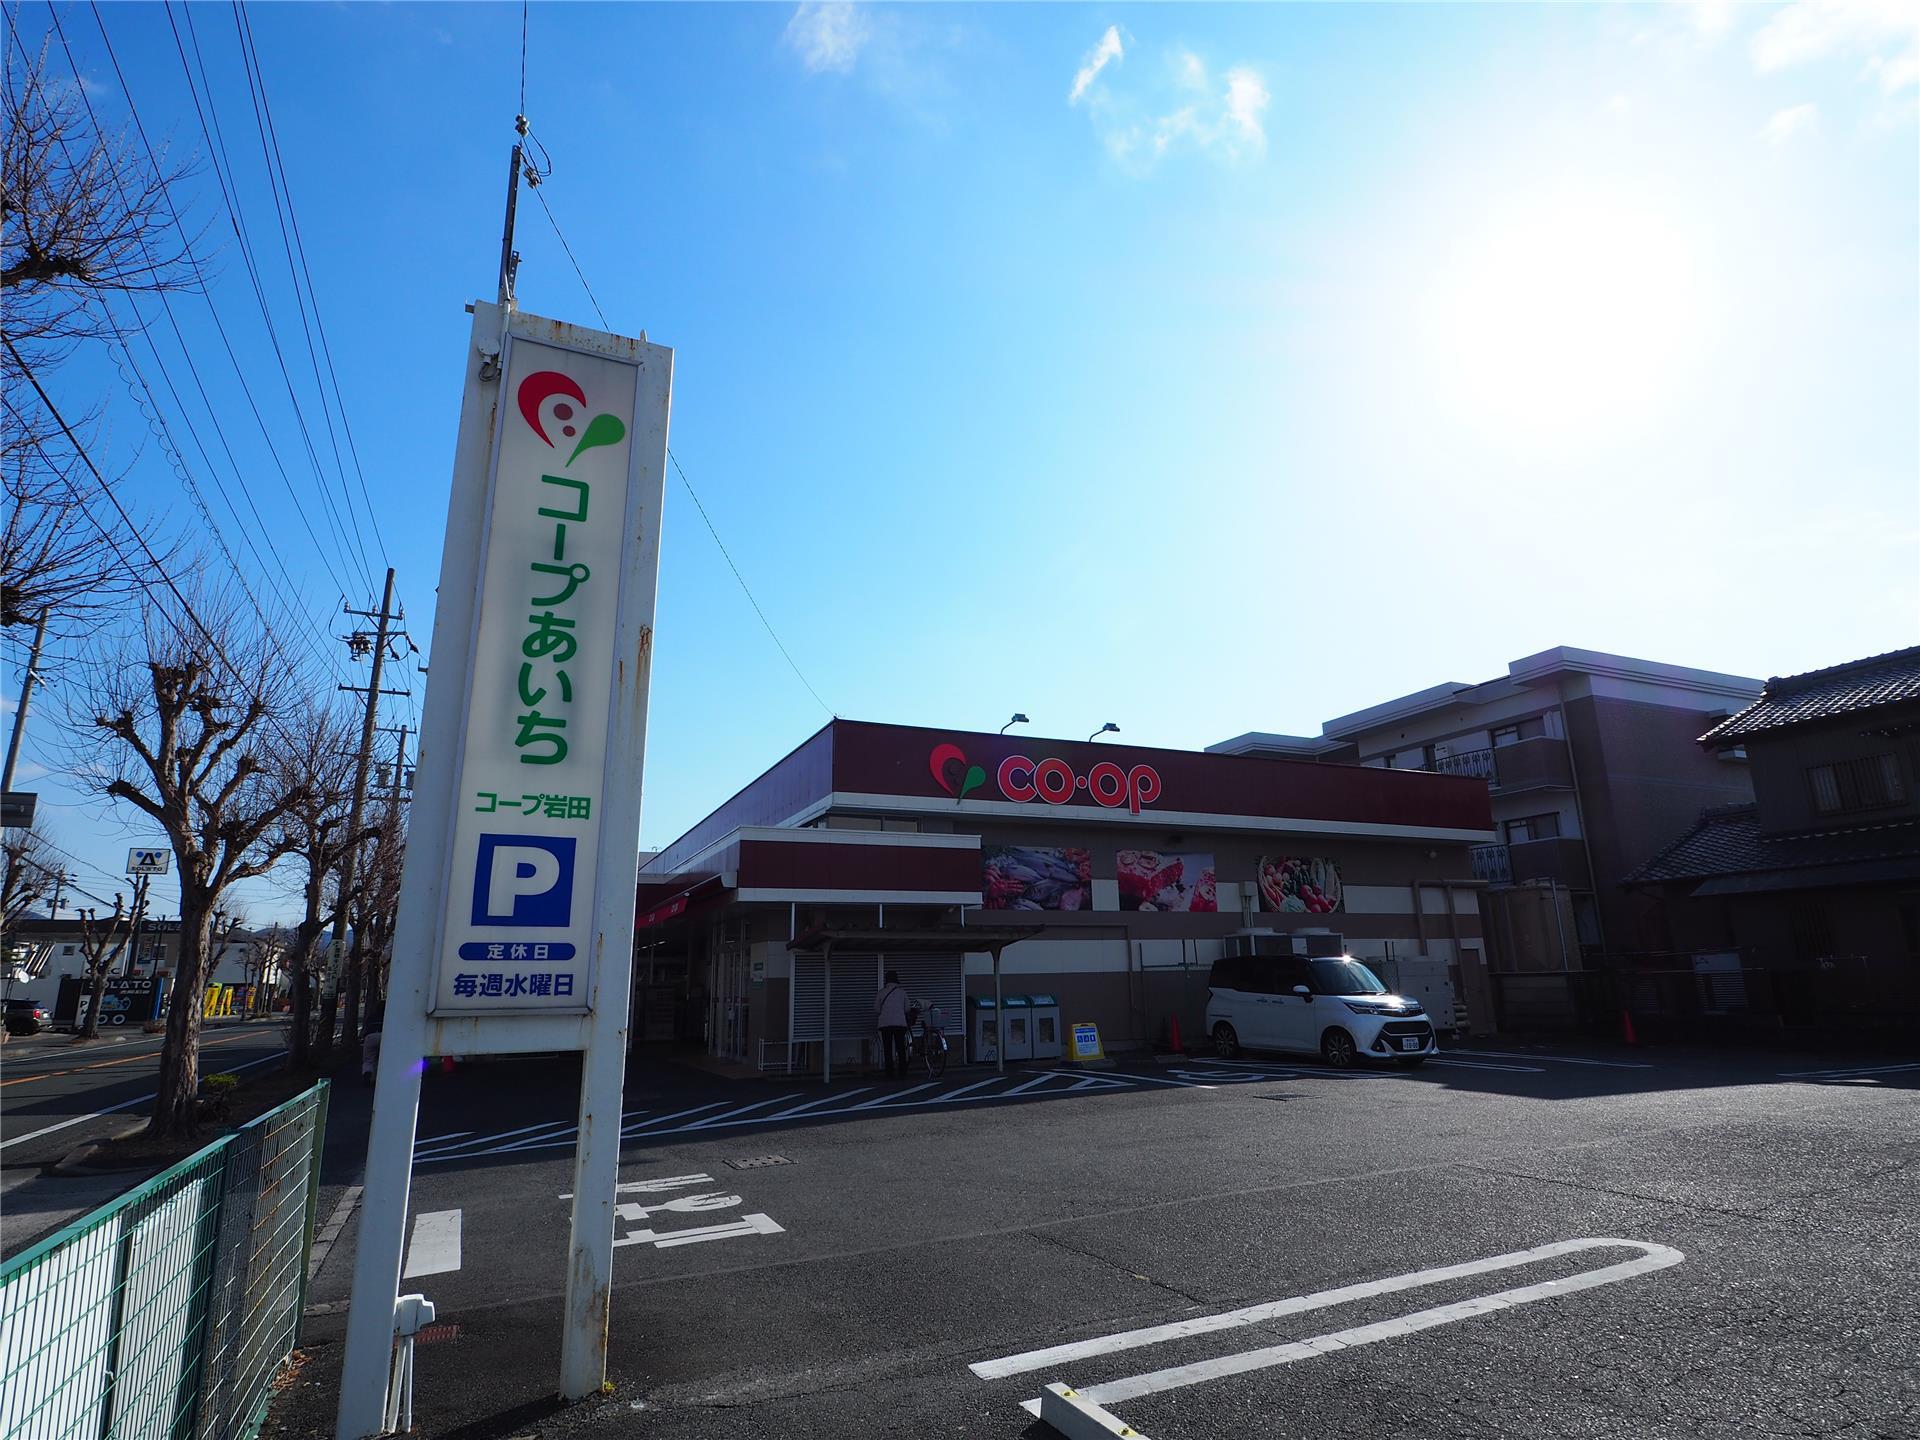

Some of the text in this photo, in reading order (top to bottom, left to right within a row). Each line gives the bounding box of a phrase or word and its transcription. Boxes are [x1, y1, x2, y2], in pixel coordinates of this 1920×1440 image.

[514, 473, 591, 765] コープあいち
[474, 792, 591, 820] コープ岩田
[487, 845, 560, 917] P
[487, 944, 549, 959] 定休日
[453, 973, 574, 997] 毎週水曜日
